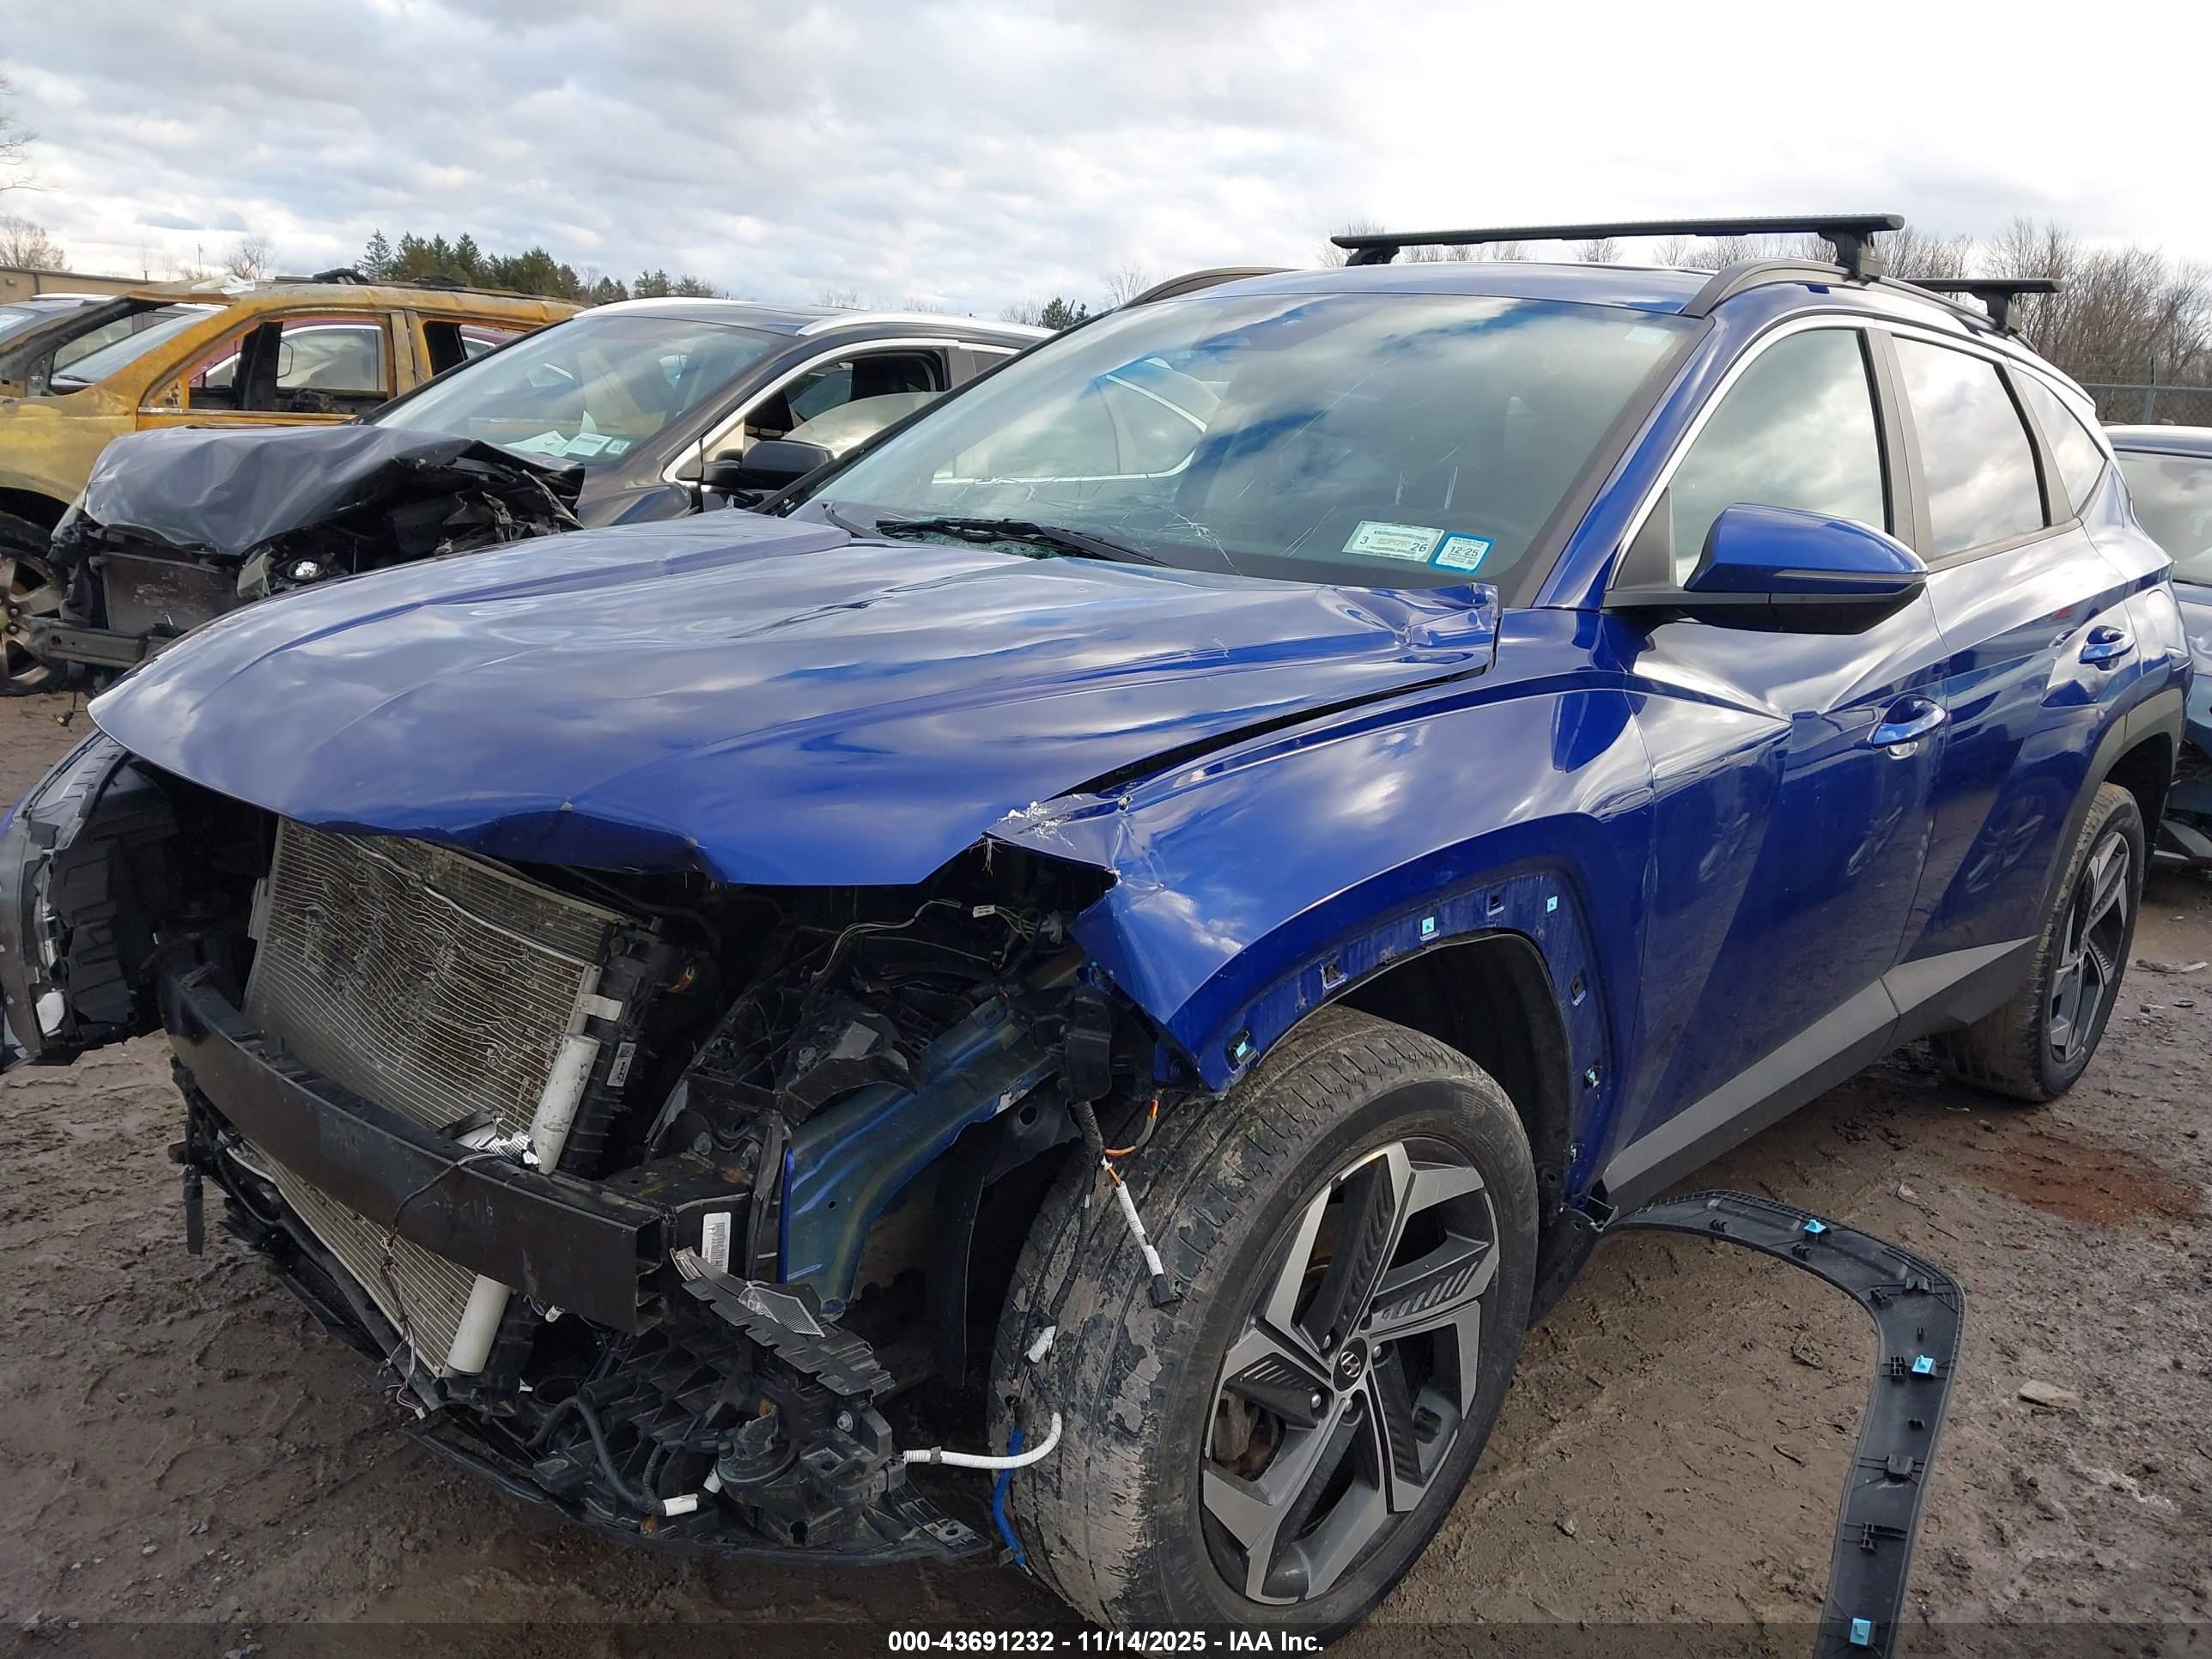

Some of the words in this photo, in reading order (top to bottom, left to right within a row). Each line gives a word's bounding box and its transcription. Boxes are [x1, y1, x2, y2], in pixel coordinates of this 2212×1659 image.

[1360, 536, 1369, 544] 3
[1410, 543, 1428, 552] 26
[1450, 546, 1480, 556] 12-25
